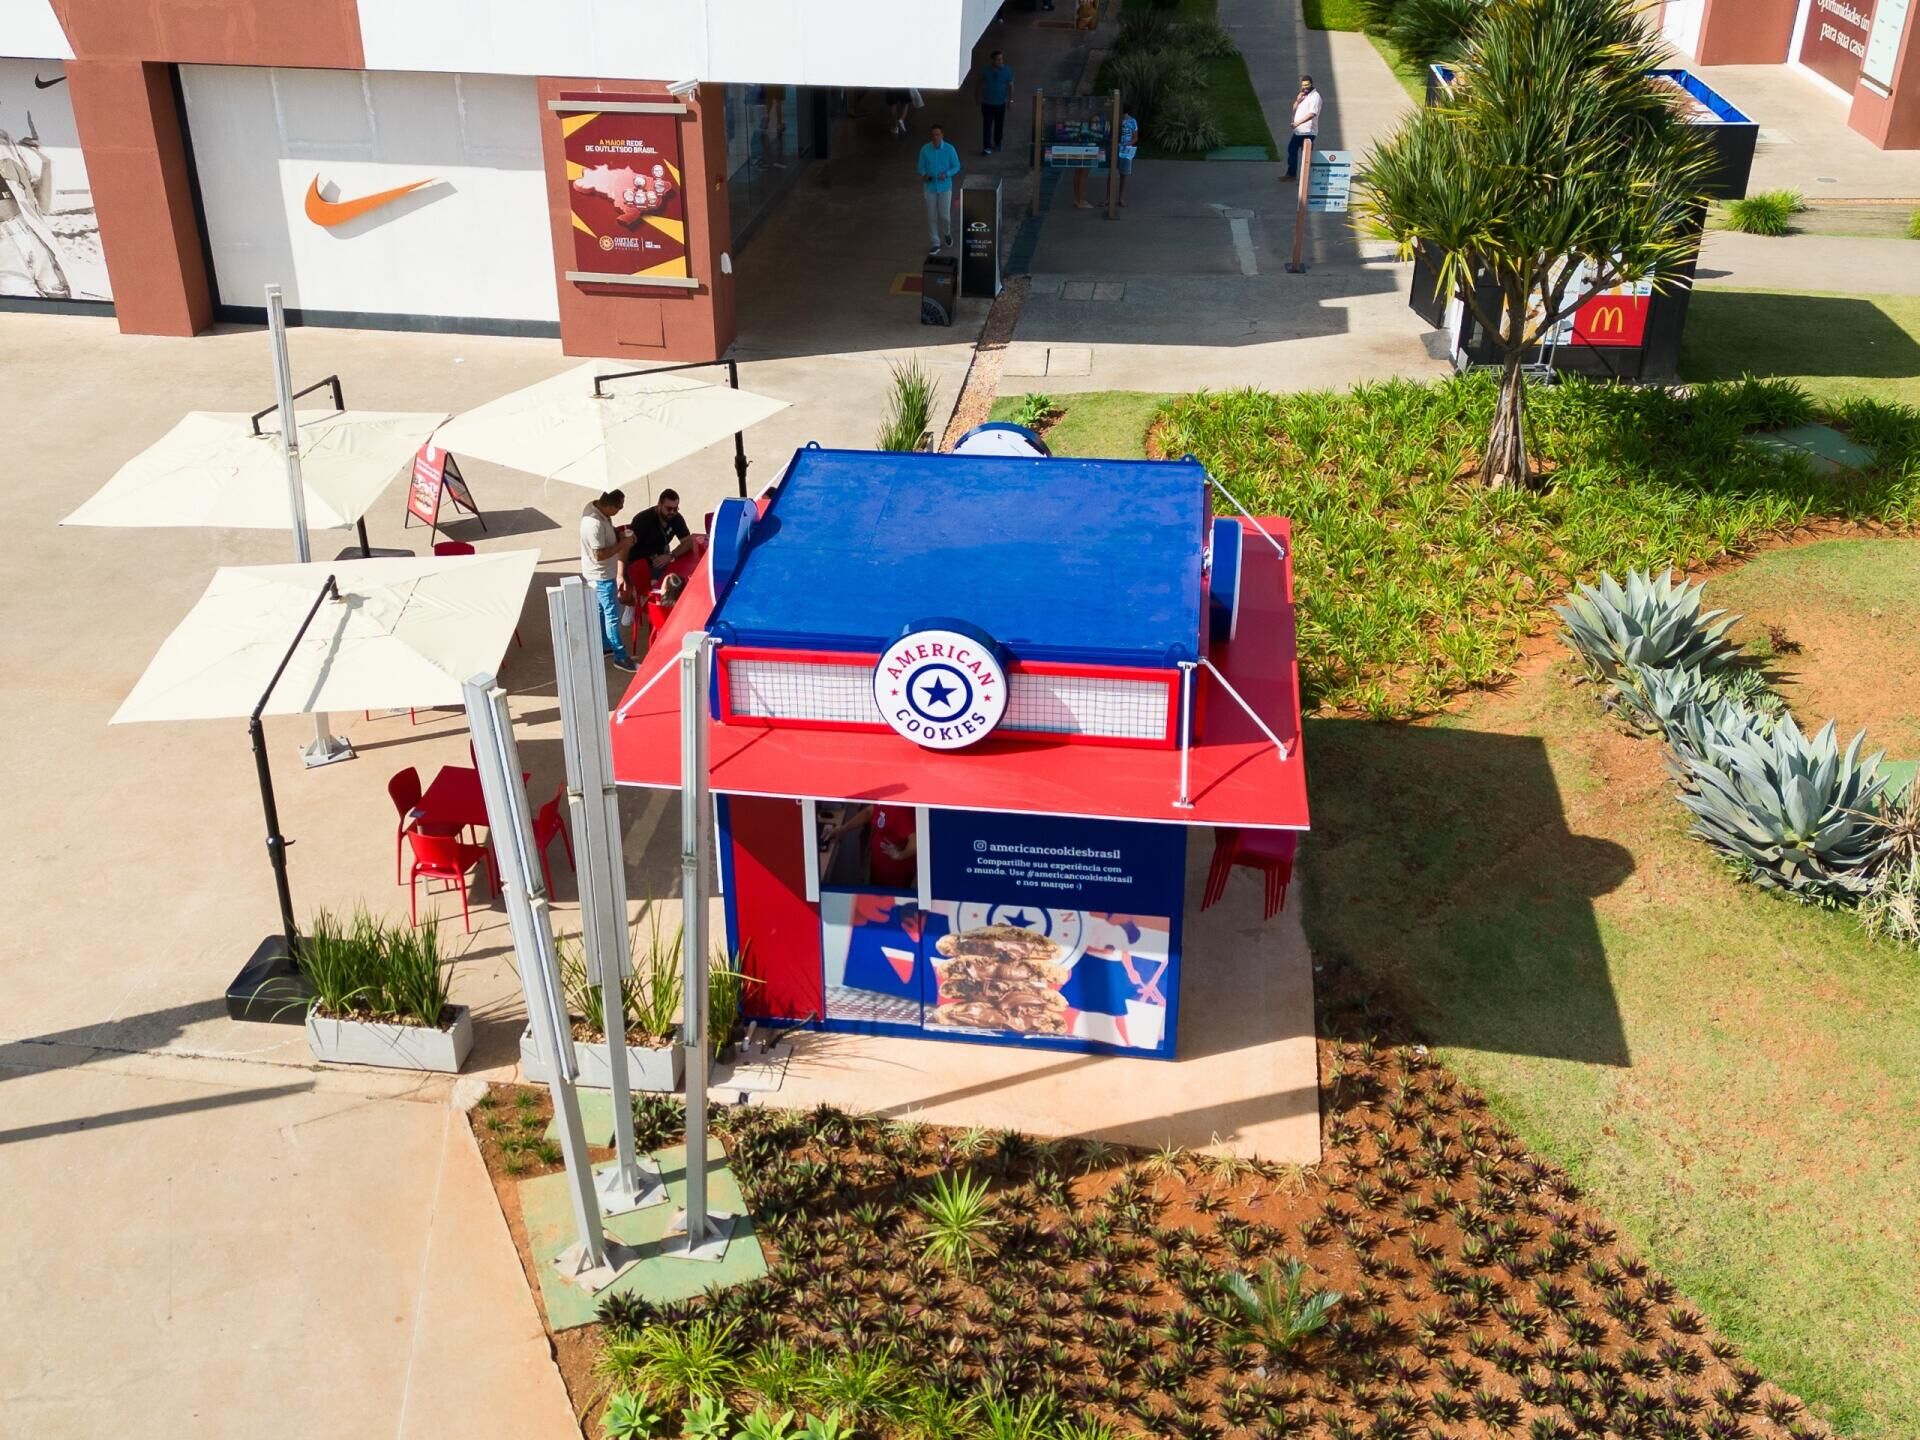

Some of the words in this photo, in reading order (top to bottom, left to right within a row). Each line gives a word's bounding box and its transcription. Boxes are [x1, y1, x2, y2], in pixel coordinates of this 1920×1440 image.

[1820, 23, 1838, 42] para
[1837, 32, 1850, 50] sua
[1849, 39, 1865, 59] casa
[887, 643, 996, 687] AMERICAN
[896, 708, 986, 741] COOKIES
[989, 843, 1121, 859] americancookiesbrasil
[977, 857, 1031, 867] Compartilhe
[1050, 863, 1101, 872] experiência
[974, 867, 1007, 876] mundo.
[1009, 868, 1025, 876] Use
[1027, 870, 1133, 884] #americancookiesbrasil
[1040, 881, 1075, 890] marque
